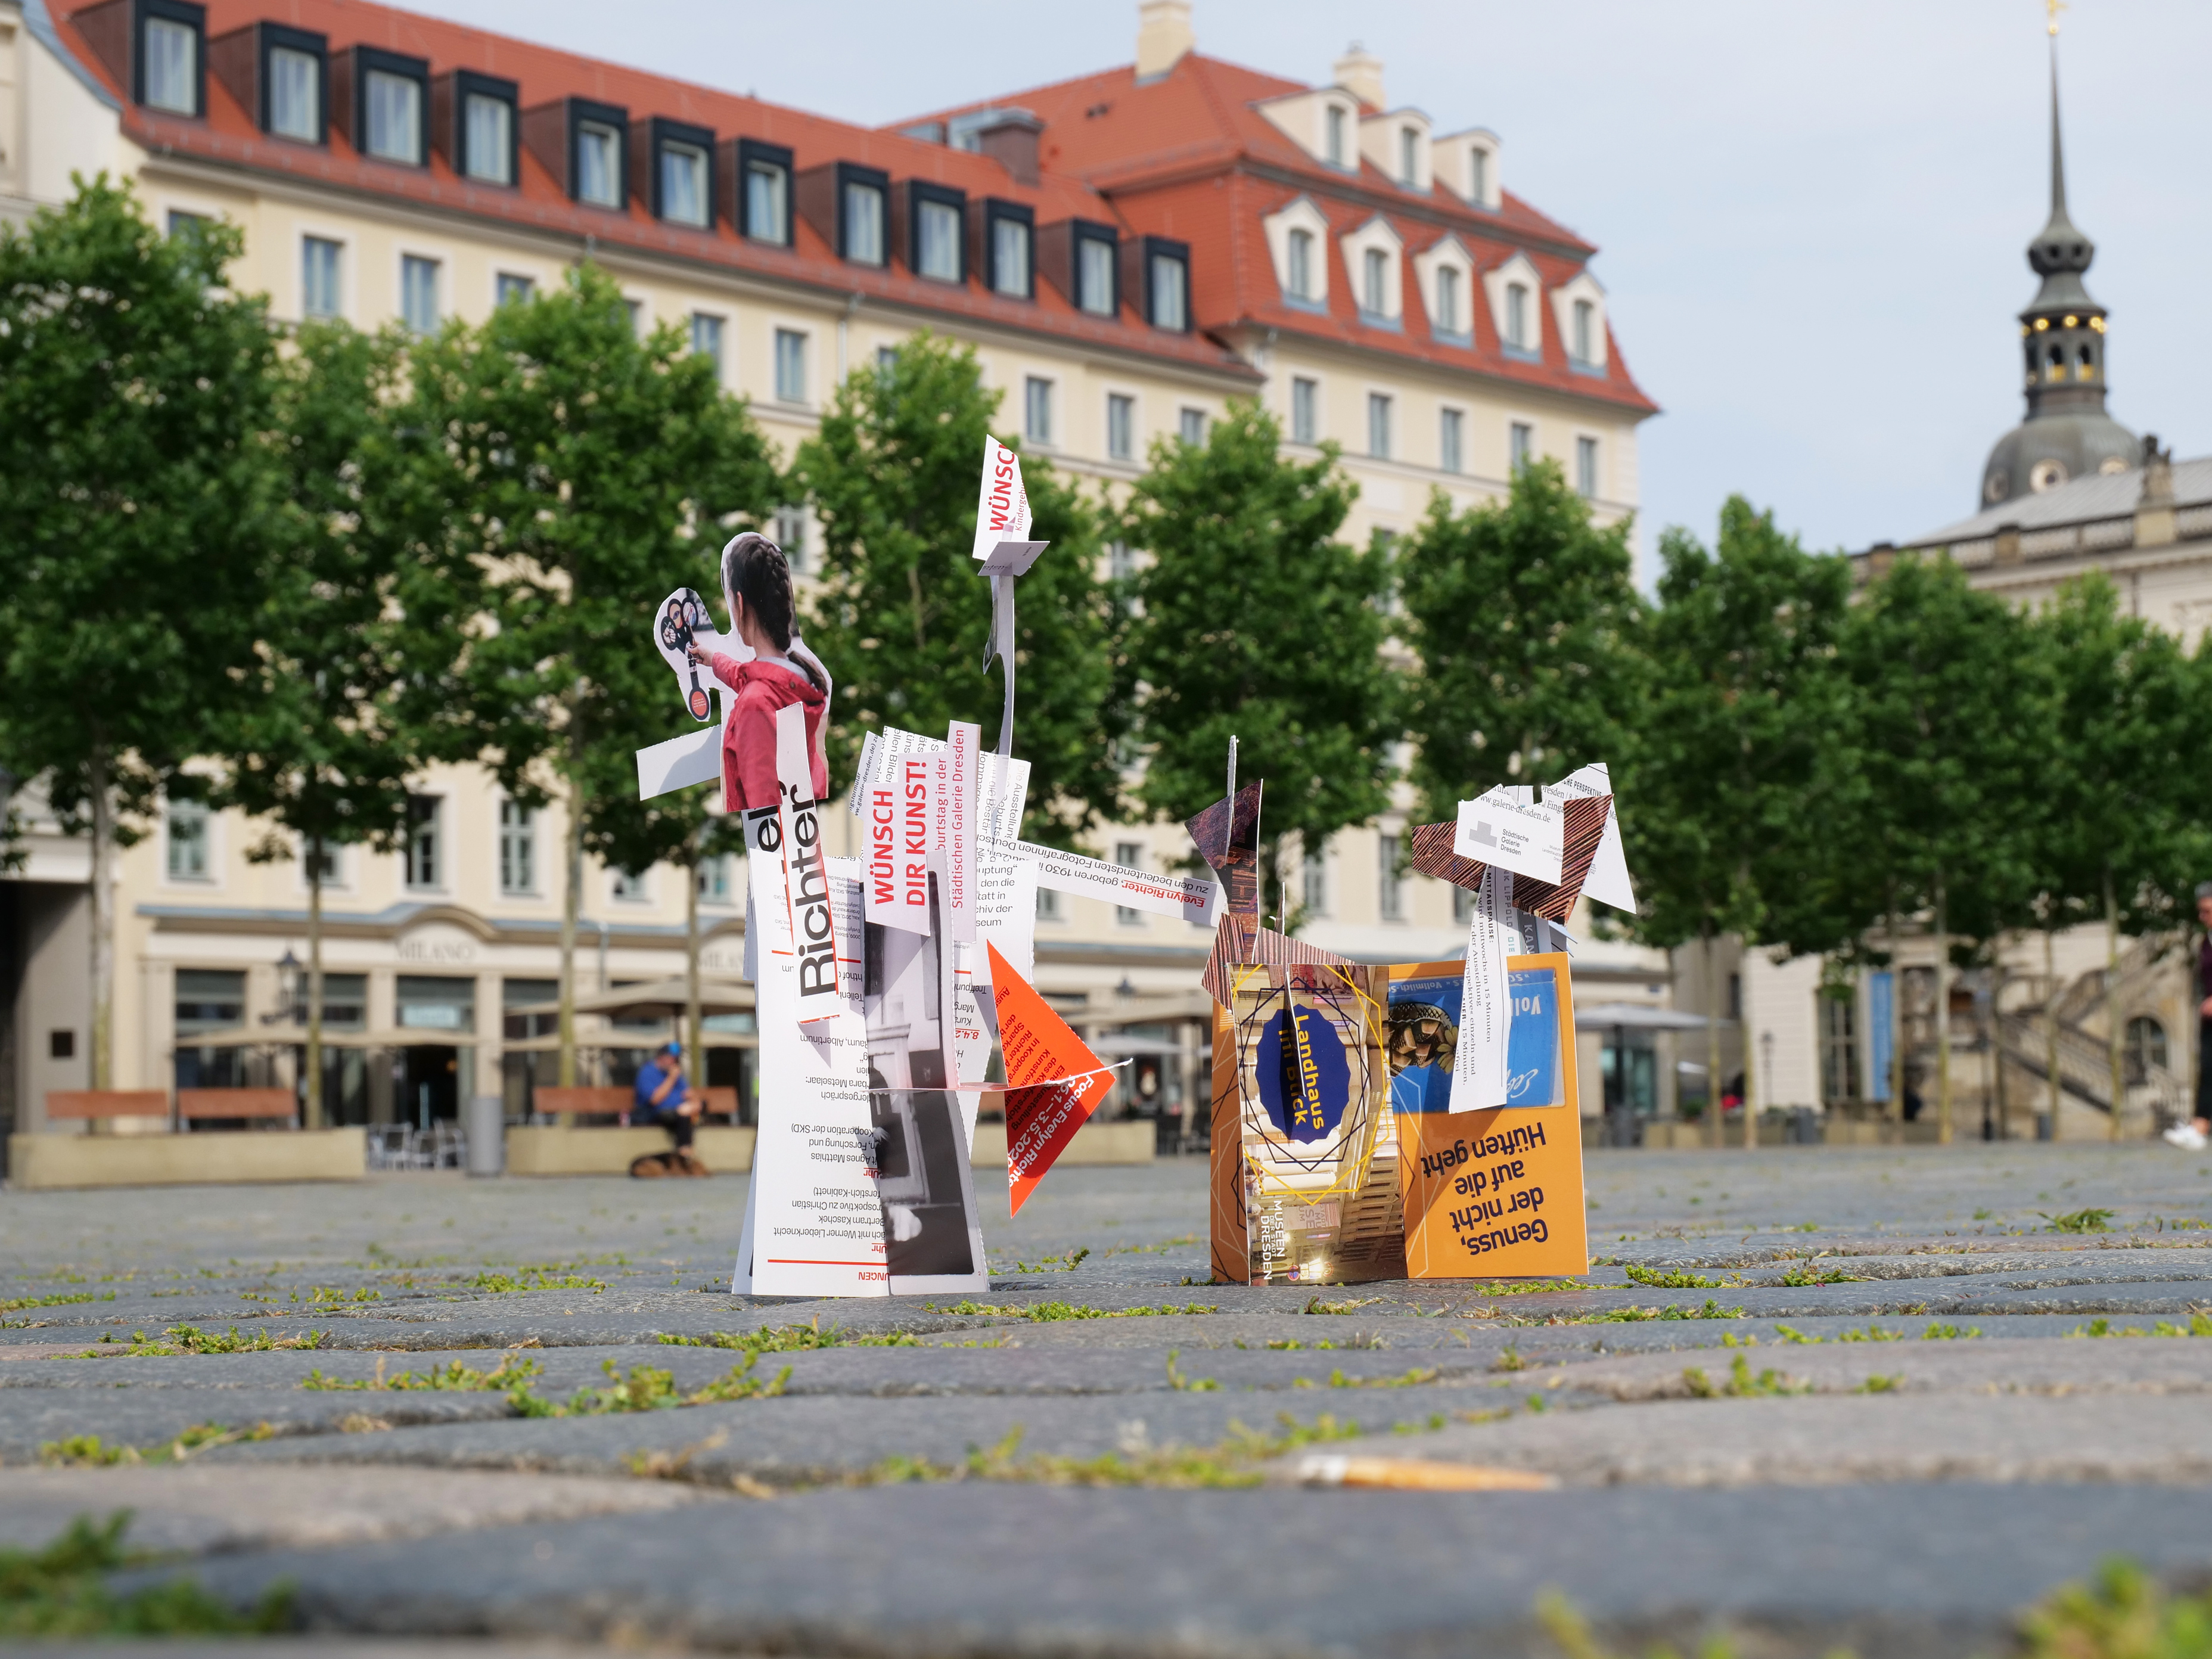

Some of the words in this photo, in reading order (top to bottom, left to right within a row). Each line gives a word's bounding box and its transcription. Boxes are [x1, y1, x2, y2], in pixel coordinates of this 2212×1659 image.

[892, 729, 901, 752] ellen
[905, 732, 915, 753] üns
[952, 729, 964, 781] Dresden
[935, 759, 946, 778] der
[936, 784, 946, 794] in
[906, 761, 927, 855] KUNST!
[952, 785, 963, 830] Galerie
[1501, 837, 1520, 847] Galerie
[1502, 829, 1529, 842] Städtische
[869, 791, 894, 905] WÜNSCH
[1018, 844, 1092, 868] Fotografinnen
[1500, 844, 1521, 856] Dresden
[952, 834, 963, 908] Städtischen
[1046, 864, 1072, 877] 1930
[1074, 871, 1119, 886] geboren
[1094, 861, 1173, 887] bedeutendsten
[790, 784, 836, 997] Richter
[906, 863, 925, 906] DIR
[1121, 880, 1164, 898] Richter,
[1175, 880, 1194, 890] den
[1195, 886, 1209, 894] zu
[1167, 891, 1206, 908] Evelyn
[1504, 886, 1513, 931] LIPPOLD.
[1479, 922, 1488, 971] mittwochs
[1472, 950, 1481, 1007] Ausstellung
[1483, 974, 1488, 983] in
[1484, 987, 1490, 999] 15
[1005, 1014, 1016, 1030] der
[800, 1034, 844, 1047] Albertinum
[1462, 1028, 1467, 1038] 15
[1009, 1030, 1032, 1061] Richter
[1030, 1037, 1040, 1047] In
[1045, 1057, 1057, 1073] des
[1295, 1014, 1324, 1130] Landhaus
[806, 1076, 847, 1088] Metselaar:
[821, 1091, 870, 1103] lergespräch
[1064, 1075, 1095, 1112] Focus
[1011, 1086, 1052, 1130] usstellung
[791, 1123, 810, 1133] SKD)
[1033, 1110, 1067, 1150] Evelyn
[809, 1139, 824, 1147] und
[825, 1138, 867, 1150] Forschung
[1471, 1121, 1546, 1158] Hüften
[810, 1152, 845, 1163] Matthias
[847, 1154, 871, 1164] Agnes
[1420, 1139, 1469, 1179] geht
[863, 1169, 879, 1179] Uhr
[1491, 1160, 1525, 1192] auf
[1455, 1172, 1487, 1198] die
[792, 1200, 828, 1210] Christian
[1507, 1186, 1544, 1212] der
[818, 1215, 852, 1225] Kaschek
[1449, 1198, 1503, 1233] nicht
[773, 1227, 825, 1238] Lieberknecht
[827, 1229, 857, 1239] Werner
[858, 1230, 871, 1239] mit
[1273, 1200, 1285, 1257] MUSEEN
[1460, 1219, 1548, 1256] Genuss,
[871, 1244, 887, 1254] Uhr
[1260, 1215, 1272, 1280] DRESDEN
